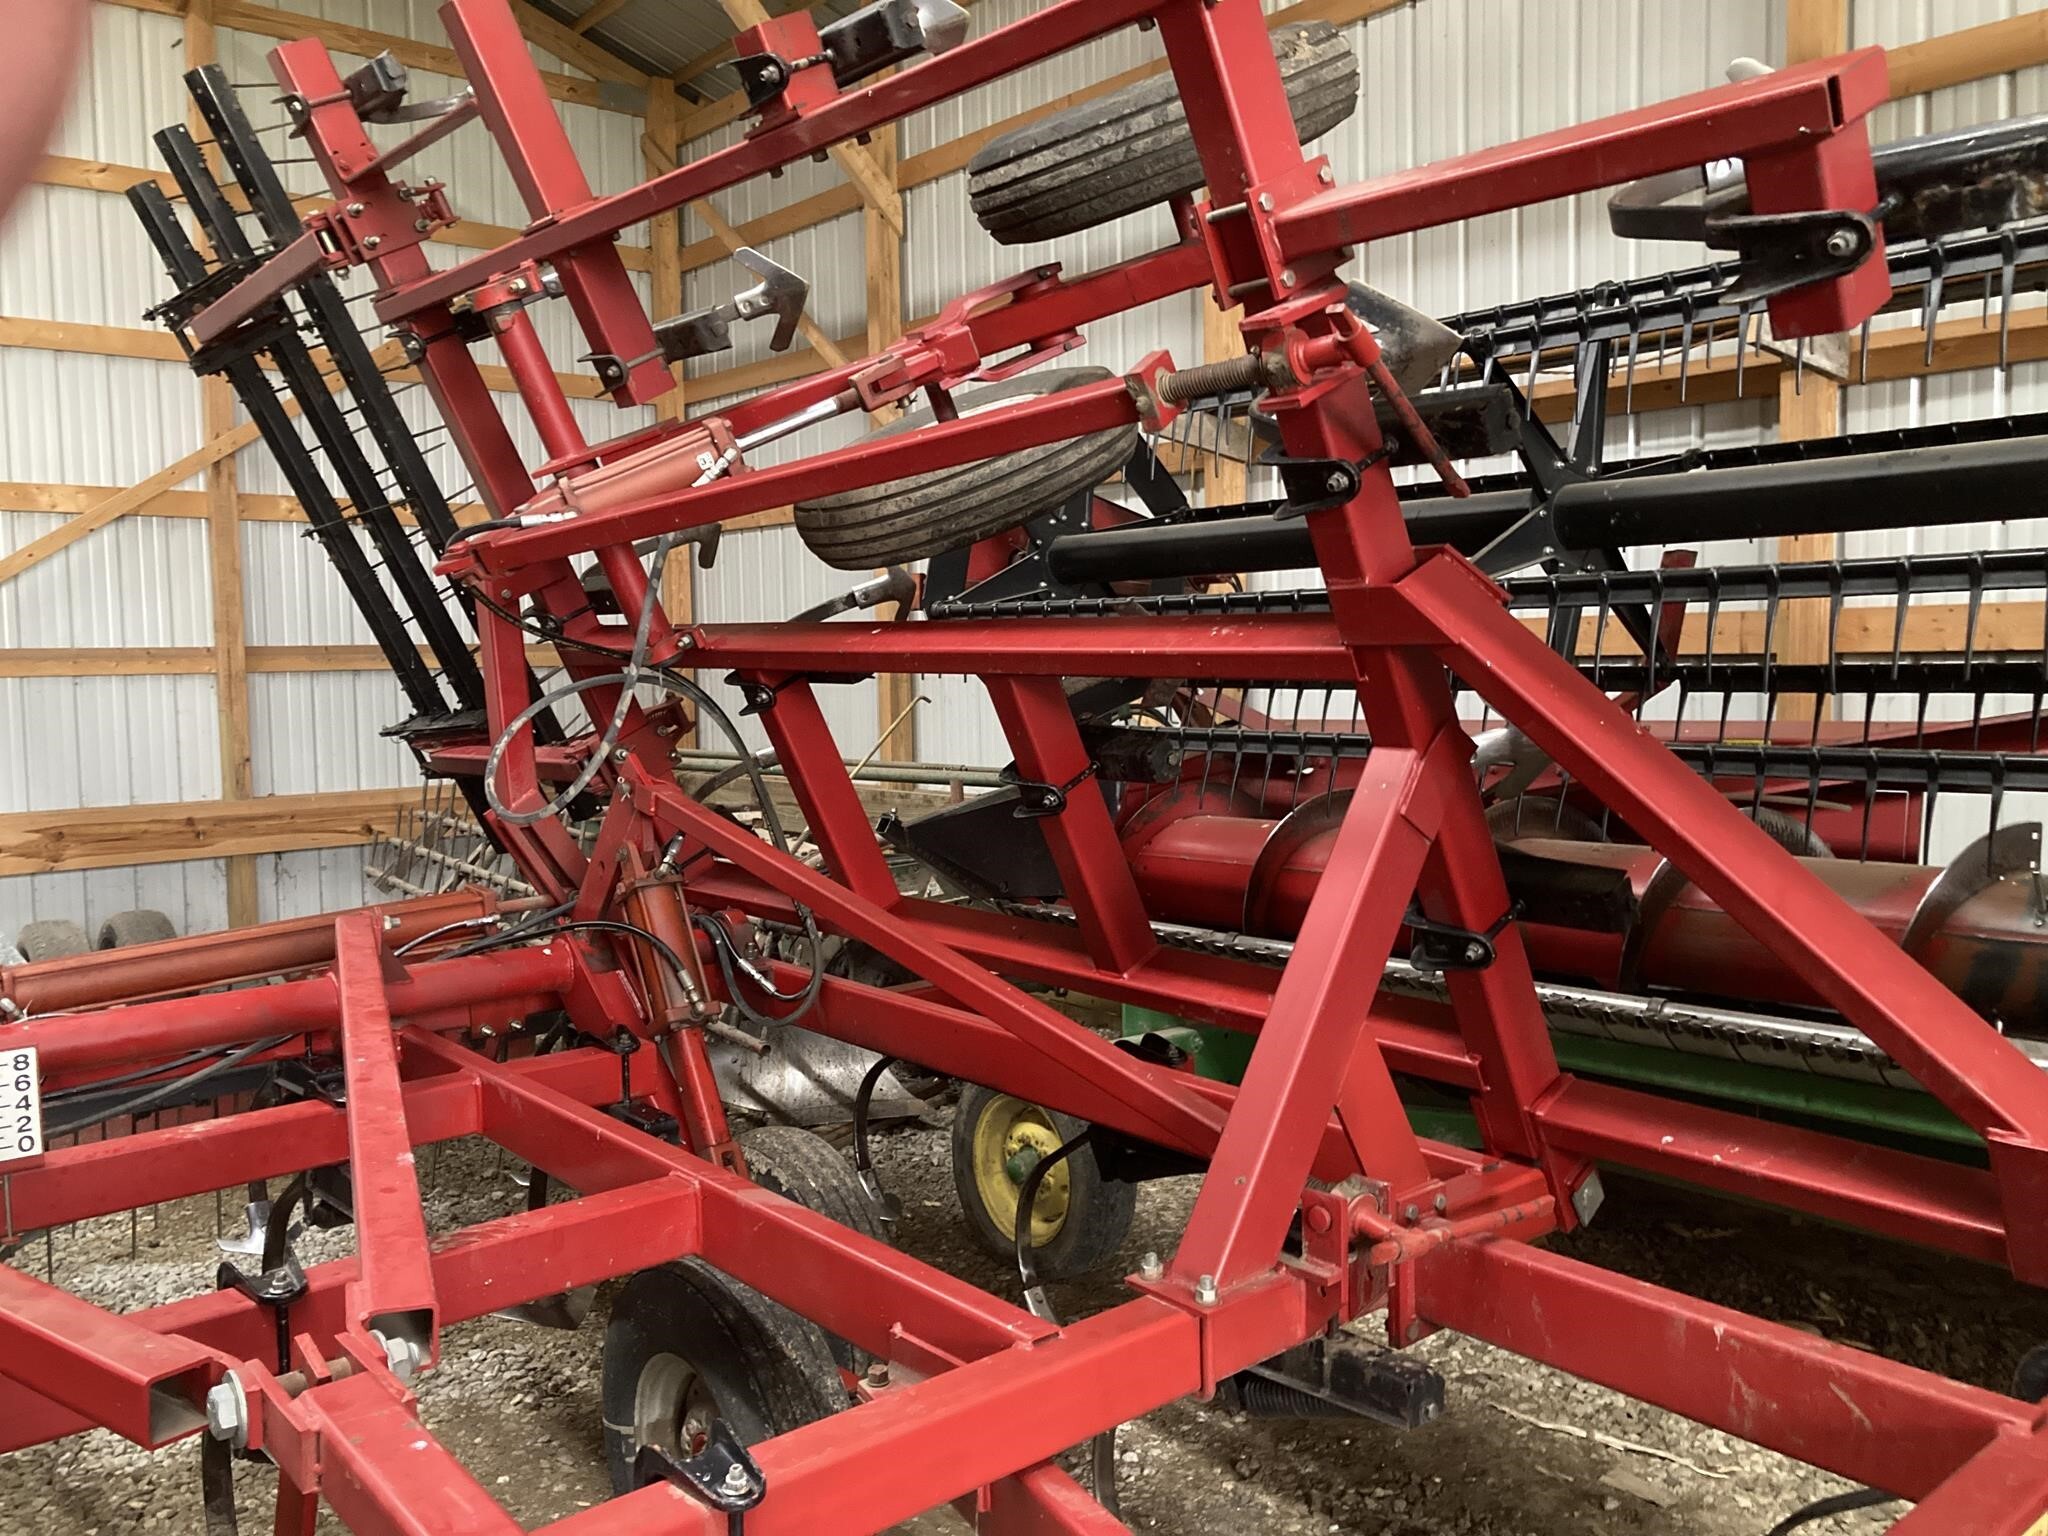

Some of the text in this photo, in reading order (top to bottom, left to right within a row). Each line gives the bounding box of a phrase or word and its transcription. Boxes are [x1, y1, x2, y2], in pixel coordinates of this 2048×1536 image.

[13, 1054, 30, 1071] 8
[14, 1074, 31, 1091] 6
[15, 1094, 32, 1111] 4
[16, 1115, 33, 1133] 2
[18, 1135, 35, 1152] 0
